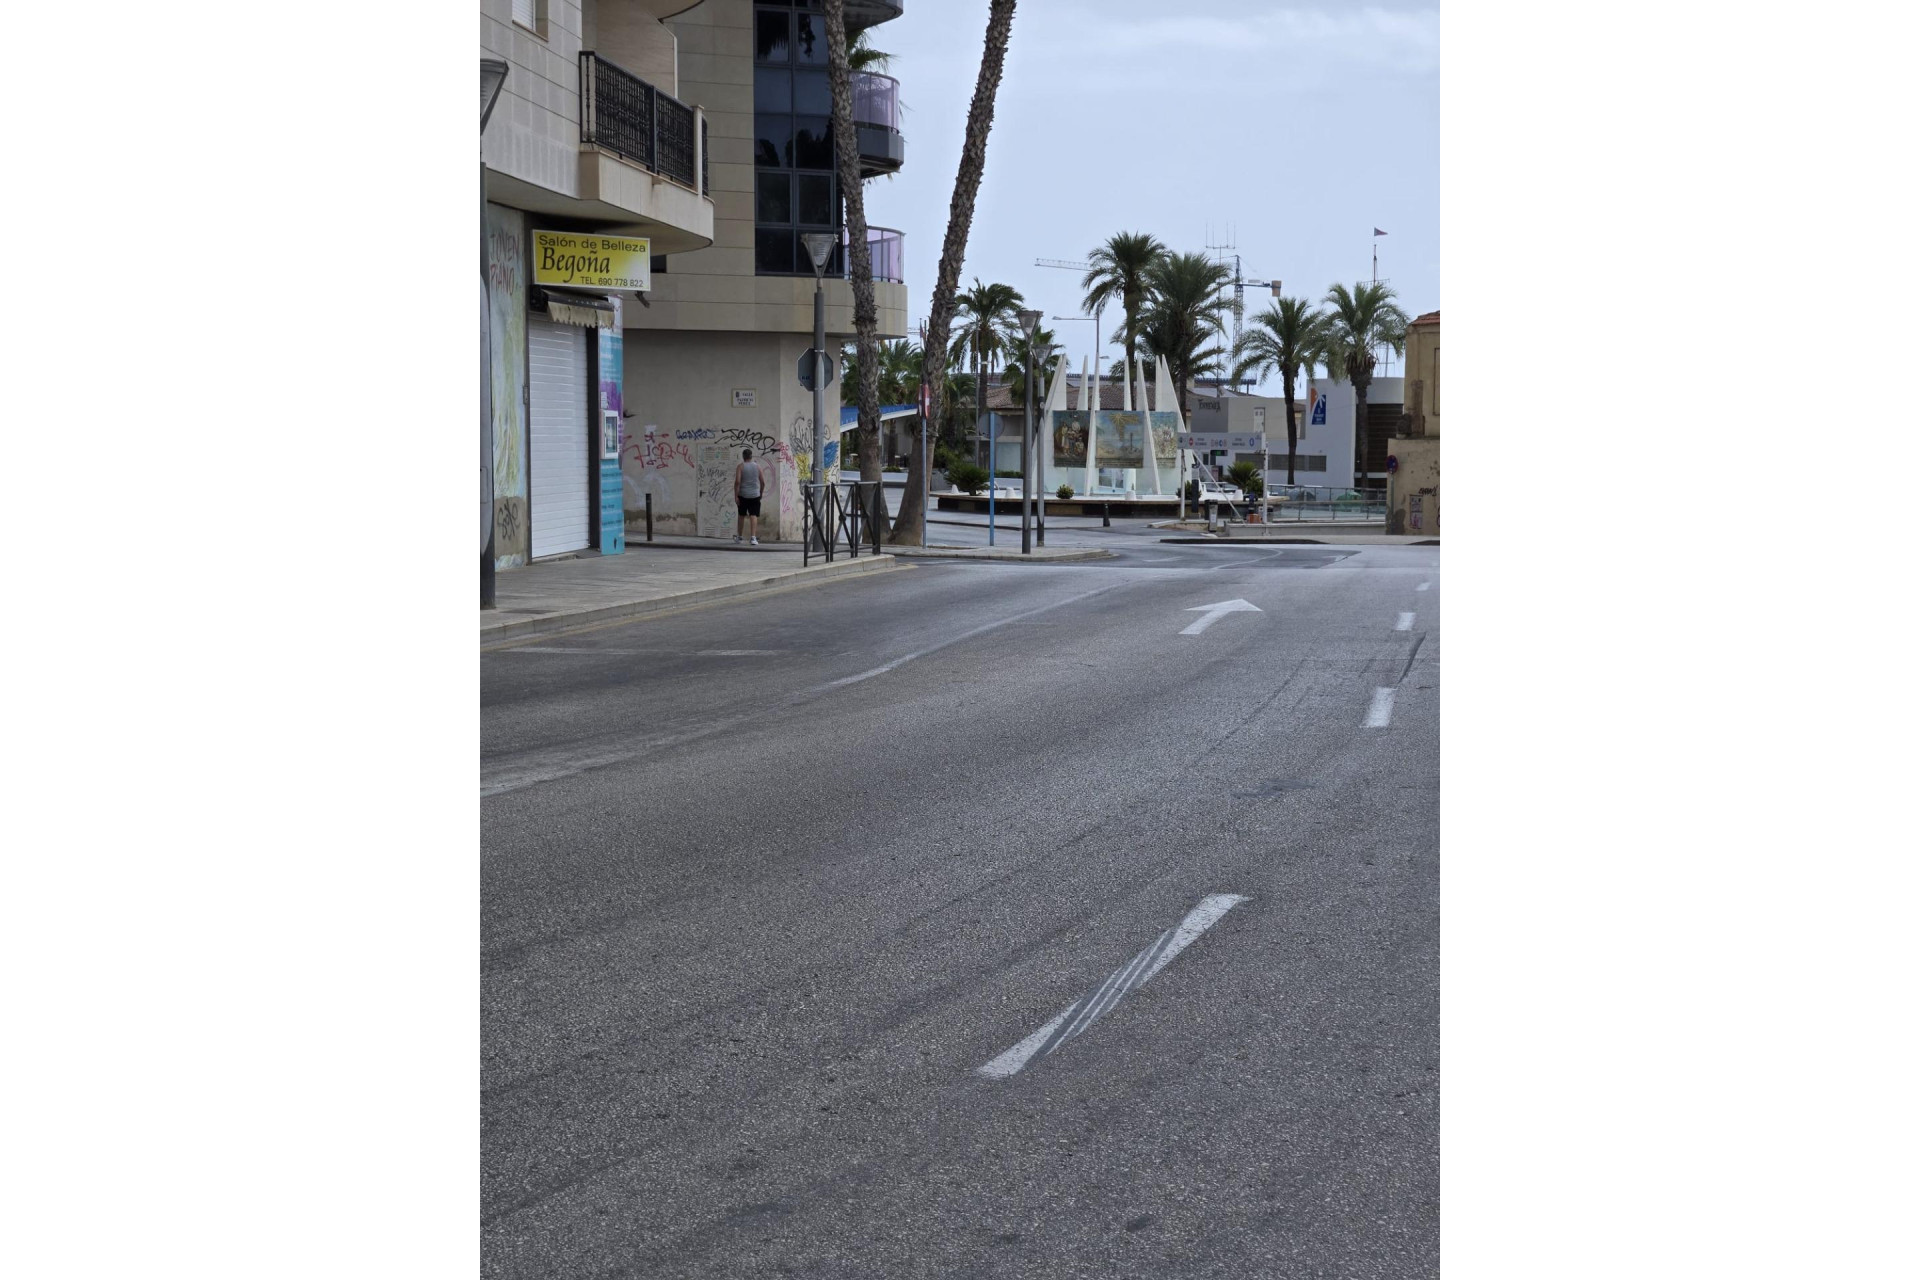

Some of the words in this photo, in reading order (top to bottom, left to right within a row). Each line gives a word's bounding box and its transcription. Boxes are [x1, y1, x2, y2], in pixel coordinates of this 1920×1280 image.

[538, 234, 577, 248] Salón
[581, 238, 598, 250] de
[601, 239, 646, 253] Belleza
[540, 246, 611, 283] Begoña
[598, 277, 613, 286] 690
[614, 278, 628, 287] 778
[630, 279, 644, 288] 822
